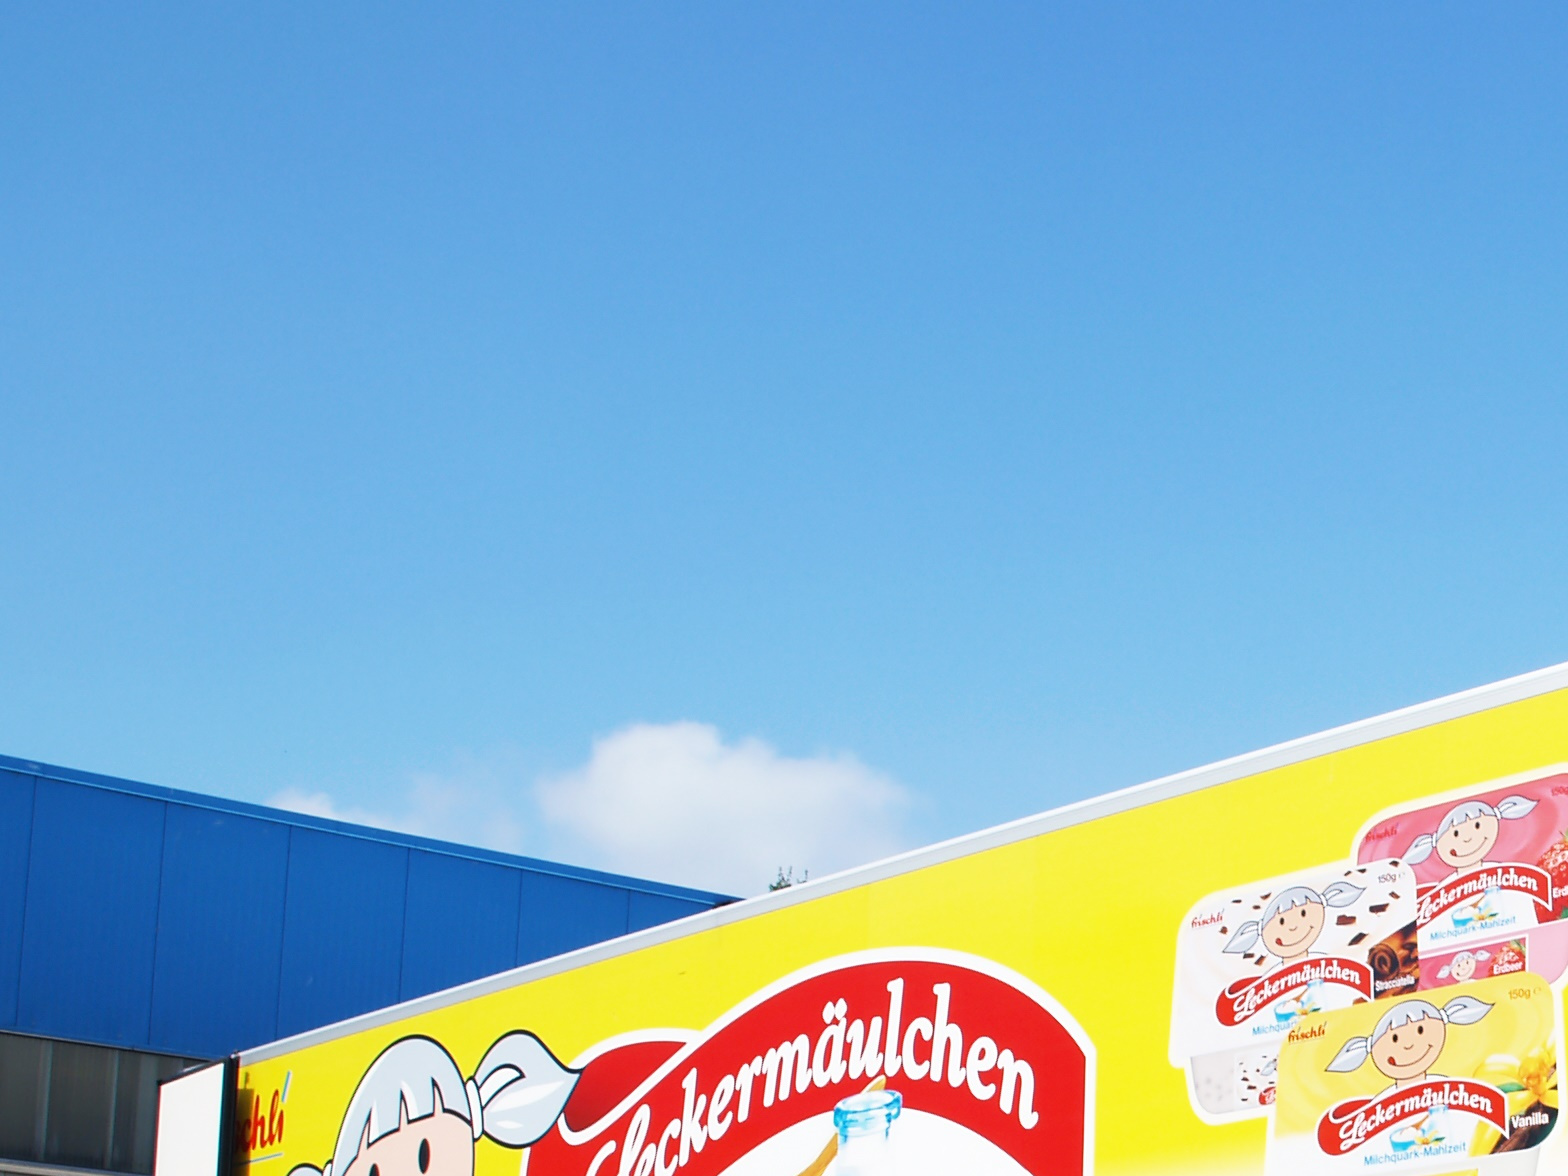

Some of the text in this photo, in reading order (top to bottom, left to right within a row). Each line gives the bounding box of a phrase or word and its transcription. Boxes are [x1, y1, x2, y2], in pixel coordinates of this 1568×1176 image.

[1191, 909, 1225, 929] frischli
[1493, 960, 1523, 975] Erdbeer
[1233, 960, 1361, 1022] Leckermäulchen
[1508, 987, 1531, 1001] 150g
[1288, 1022, 1327, 1043] frischli
[1339, 1085, 1493, 1151] Leckermäulchen
[1511, 1112, 1549, 1128] Vanilla
